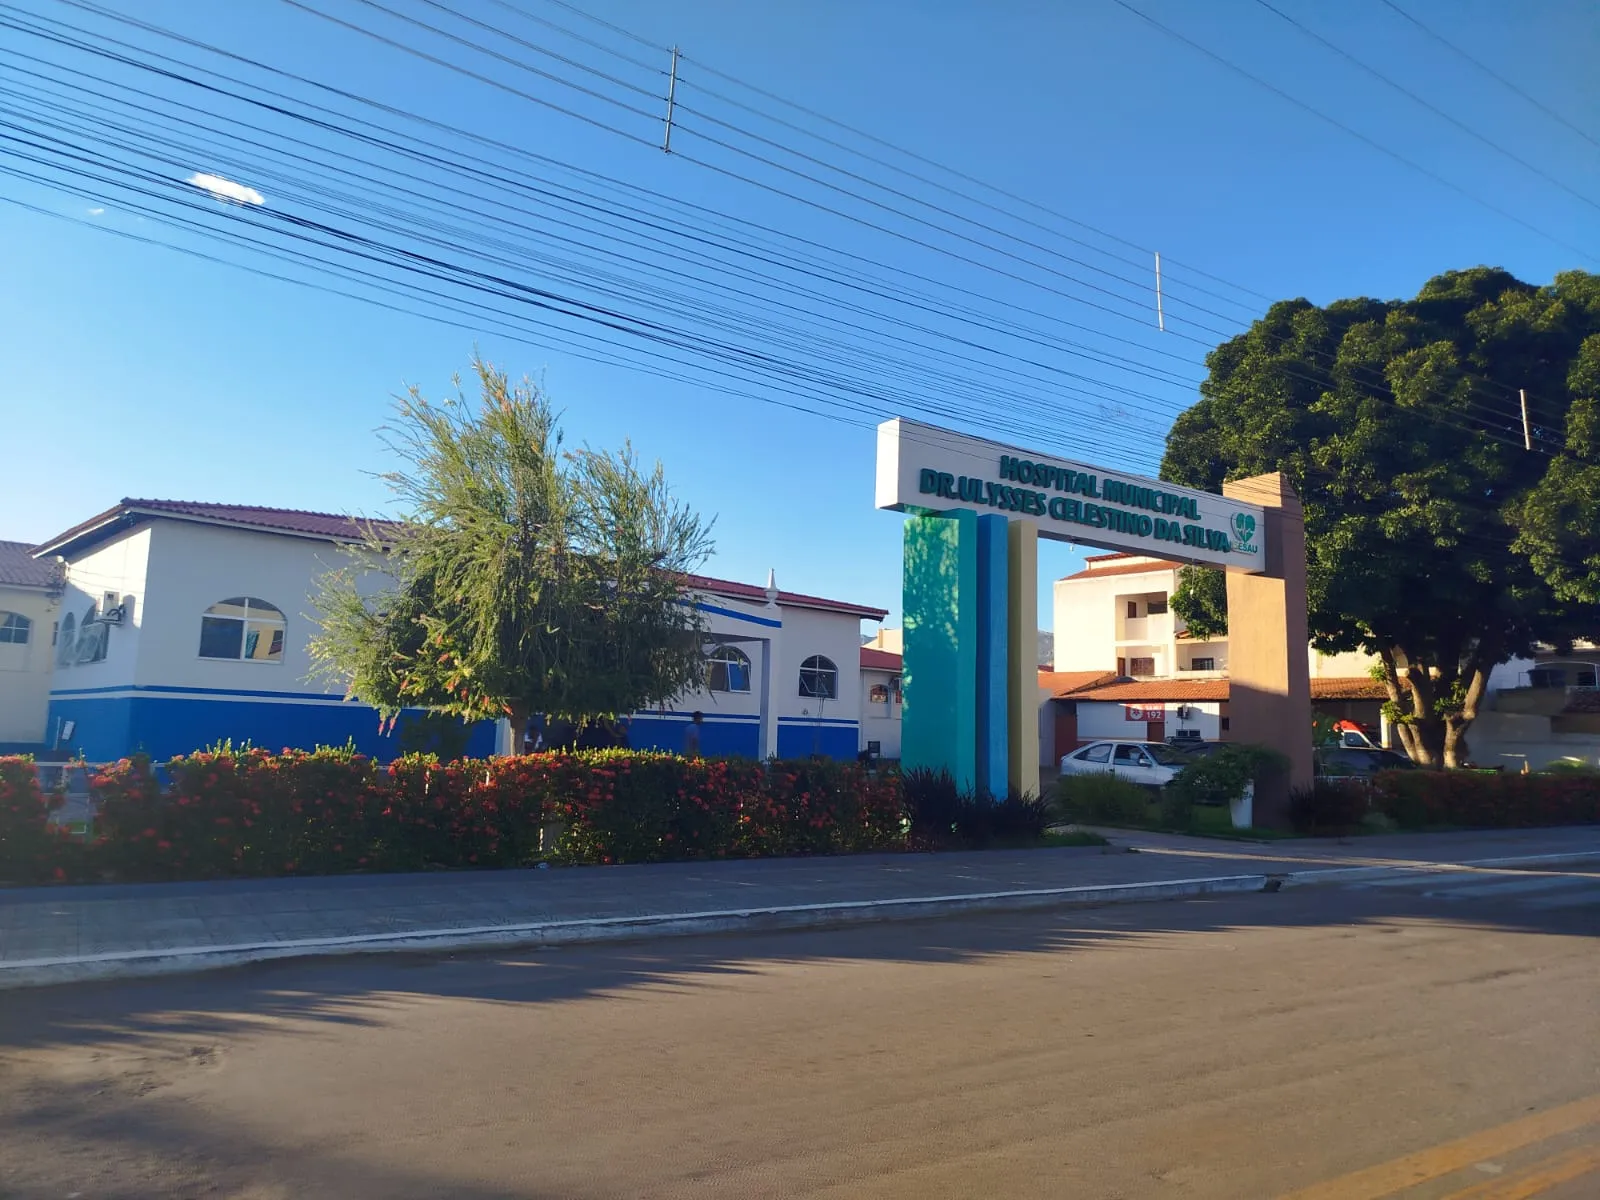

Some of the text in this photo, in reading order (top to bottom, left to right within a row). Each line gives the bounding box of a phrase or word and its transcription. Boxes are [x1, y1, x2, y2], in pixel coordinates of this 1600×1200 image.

[1000, 455, 1201, 520] HOSPITAL MUNICIPAL
[1049, 497, 1153, 537] CELESTINO
[1154, 518, 1181, 544] DA
[1182, 525, 1231, 554] SILVA
[1147, 711, 1161, 719] 192
